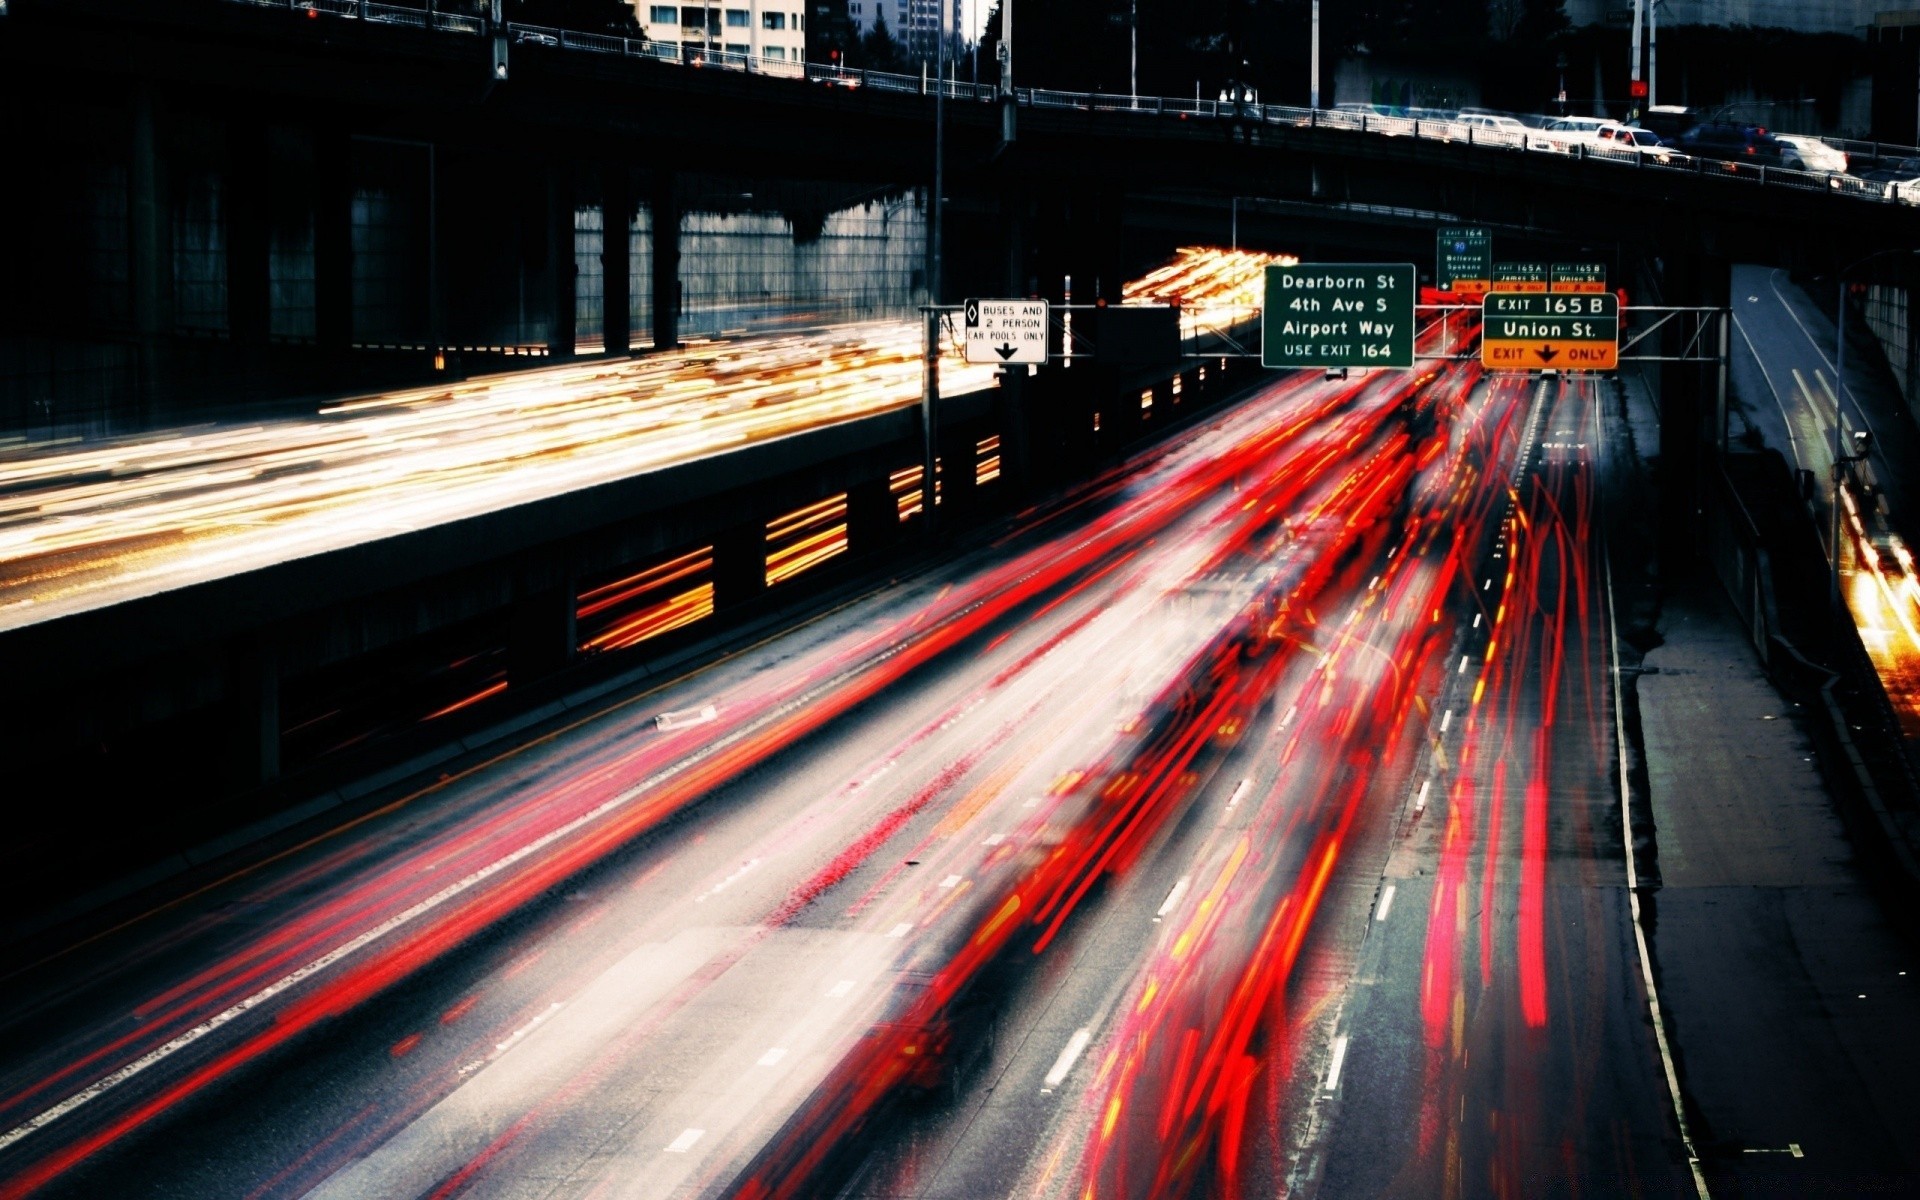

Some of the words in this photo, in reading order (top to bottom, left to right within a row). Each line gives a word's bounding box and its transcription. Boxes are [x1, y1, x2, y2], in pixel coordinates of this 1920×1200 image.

[1465, 229, 1482, 237] 164
[1455, 241, 1465, 250] 90
[1446, 254, 1482, 262] Bellevue
[1282, 274, 1365, 289] Dearborn
[1377, 275, 1395, 289] St
[1501, 273, 1527, 281] James
[1290, 298, 1320, 312] 4th
[1332, 298, 1365, 312] Ave
[1376, 298, 1387, 312] S
[1498, 299, 1531, 310] EXIT
[983, 306, 1015, 315] BUSES
[1022, 306, 1043, 315] AND
[986, 319, 993, 328] 2
[1002, 319, 1040, 328] PERSON
[1282, 321, 1348, 339] Airport
[1359, 321, 1395, 339] Way
[1504, 321, 1561, 336] Union
[1572, 322, 1596, 337] St.
[968, 331, 984, 340] CAR
[990, 331, 1016, 340] POOLS
[1024, 331, 1044, 340] ONLY
[1284, 345, 1312, 356] USE
[1321, 345, 1351, 356] EXIT
[1362, 344, 1391, 358] 164
[1493, 347, 1524, 359] EXIT
[1569, 348, 1607, 360] ONLY
